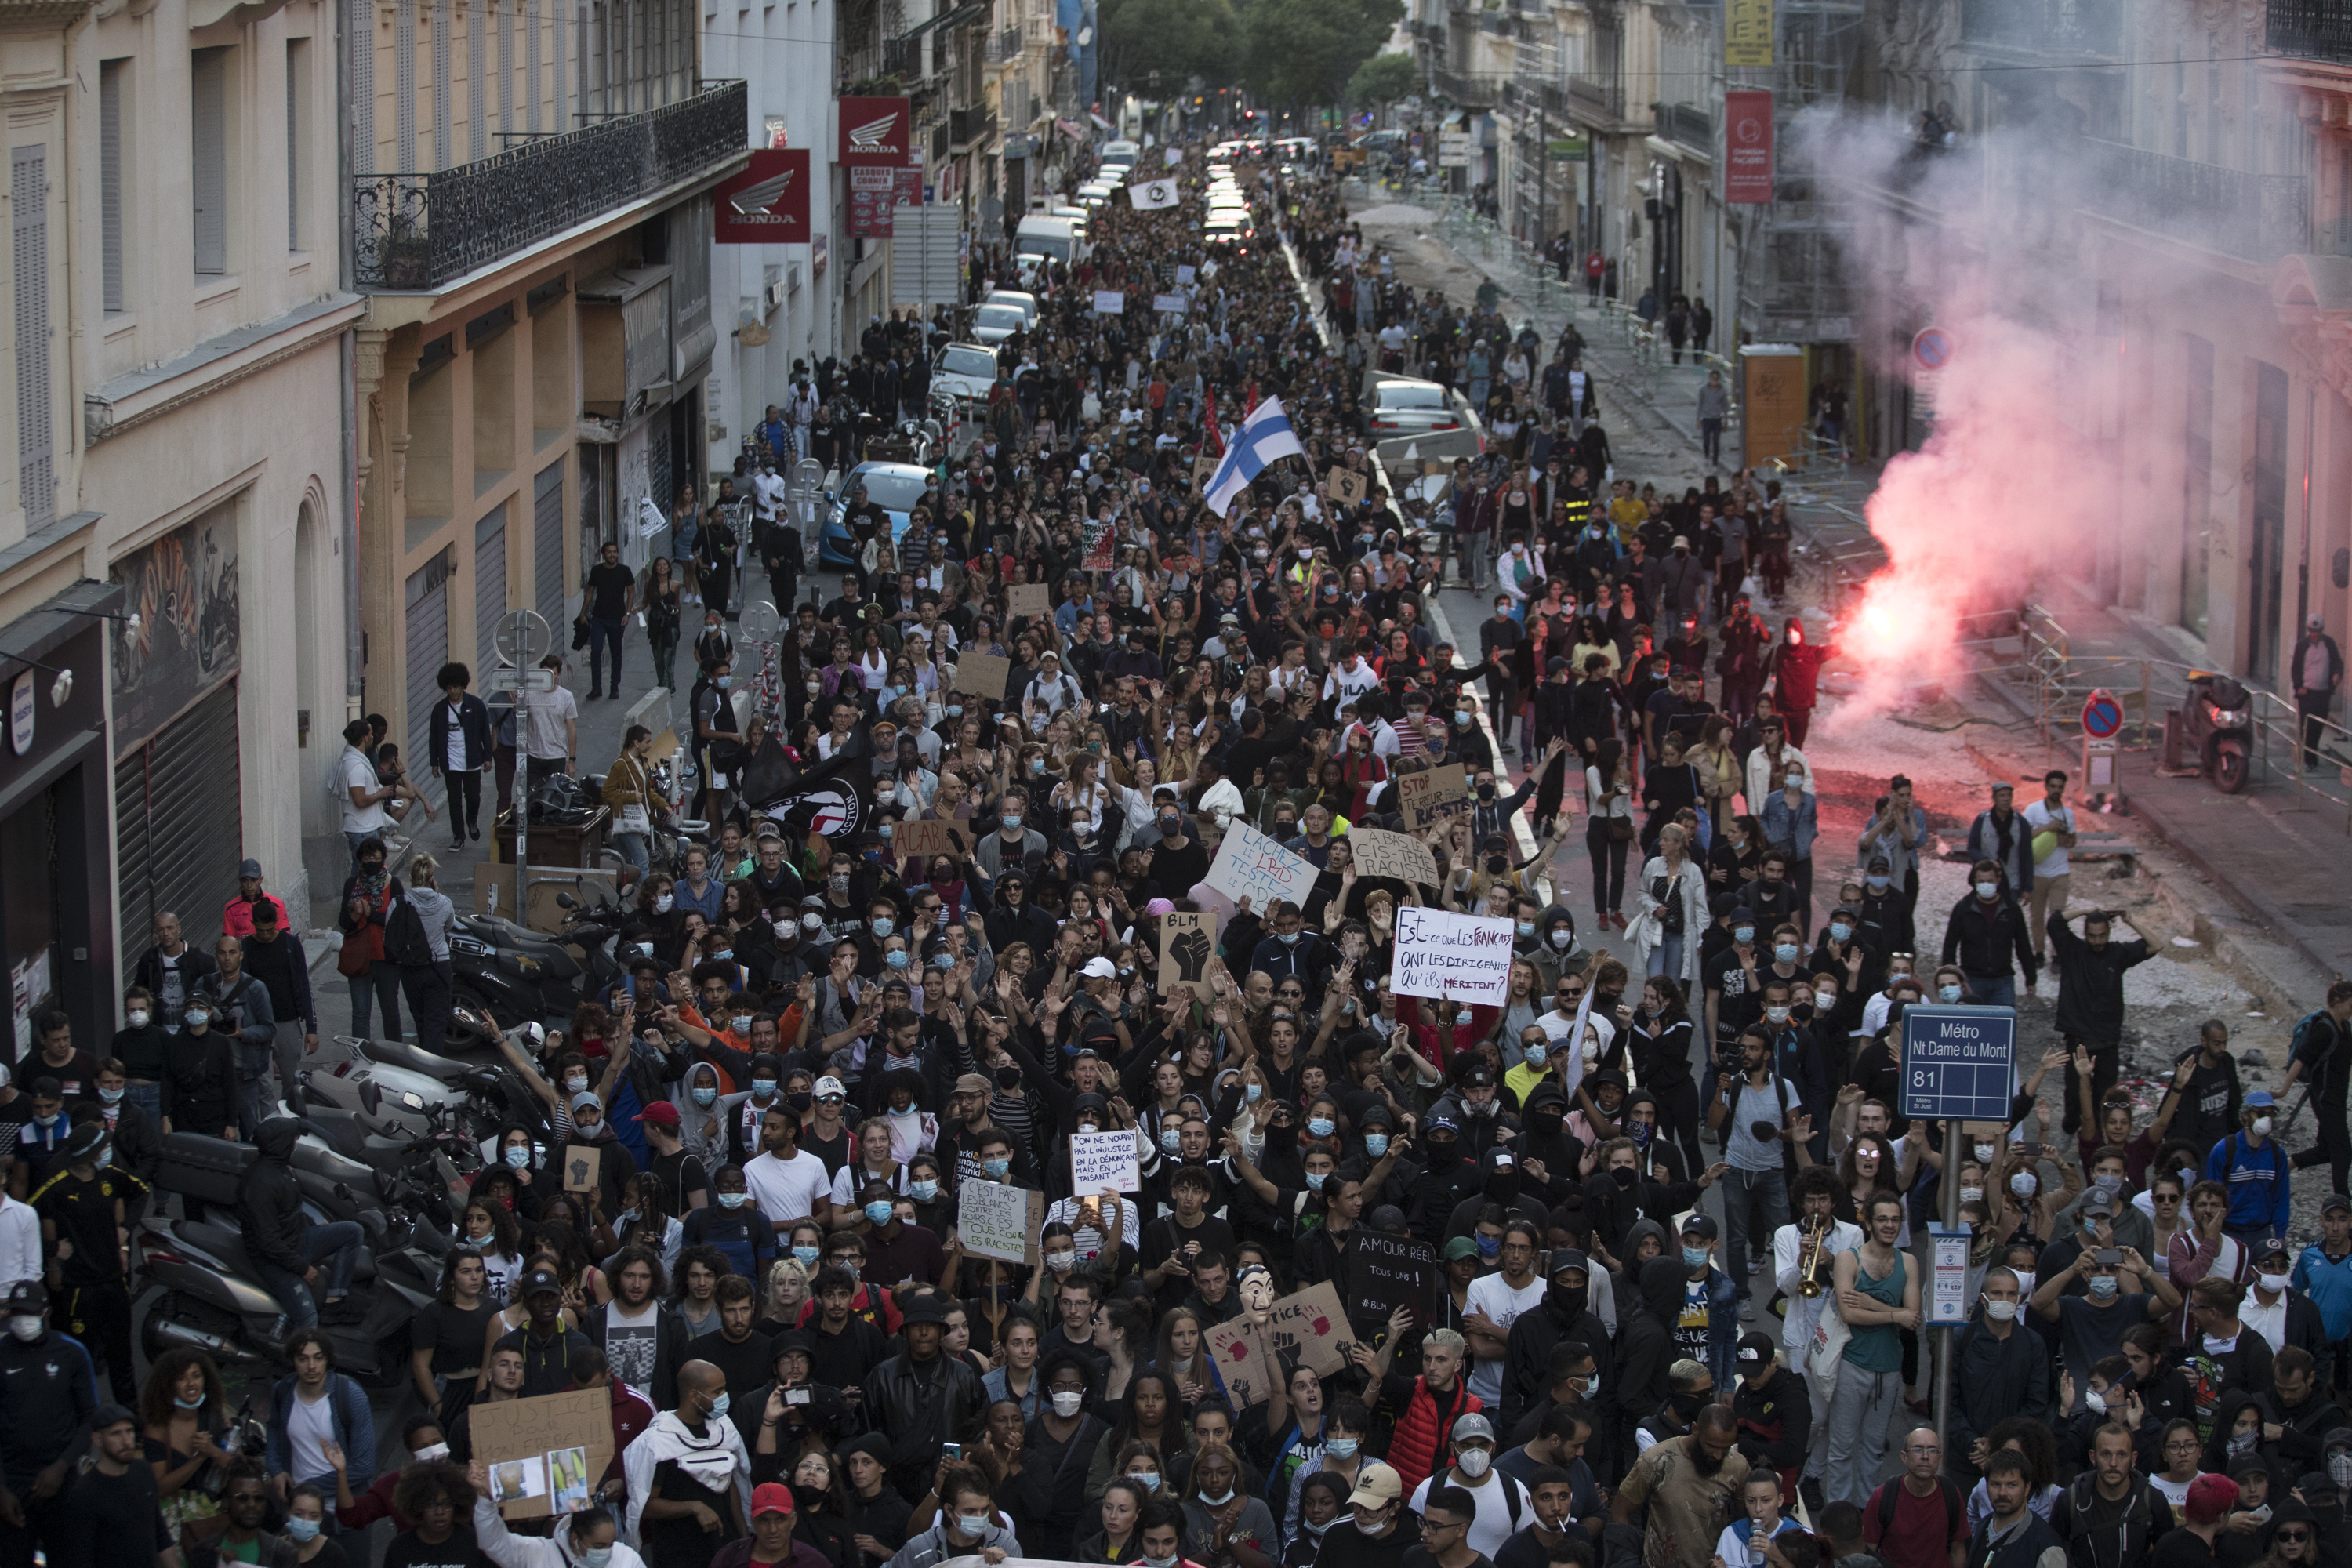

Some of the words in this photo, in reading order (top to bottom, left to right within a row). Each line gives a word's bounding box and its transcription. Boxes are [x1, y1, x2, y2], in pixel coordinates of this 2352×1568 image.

[728, 214, 797, 224] HONDA
[1401, 775, 1430, 797] STOP
[1404, 791, 1443, 811] TERREUR
[839, 793, 855, 834] ACTION
[759, 825, 775, 833] ICON
[1243, 828, 1303, 875] LACHEZ
[1369, 831, 1380, 844] A
[1382, 833, 1408, 848] BAS
[1411, 838, 1423, 853] LE
[1243, 847, 1254, 859] LE
[1256, 853, 1292, 883] LBD
[1365, 859, 1438, 887] RACISTE
[1231, 855, 1294, 902] TESTEZ
[1228, 877, 1238, 887] LE
[1242, 881, 1276, 913] CB
[1167, 914, 1198, 927] BLM
[1457, 929, 1474, 946] LES
[1474, 927, 1512, 949] FRANÇAIS
[1401, 951, 1426, 968] ONT
[1429, 953, 1445, 966] LES
[1446, 956, 1508, 971] DIRIGEANTS
[1940, 1022, 1980, 1039] Métro
[1913, 1040, 1926, 1055] Nt
[1929, 1041, 1960, 1057] Dame
[1963, 1042, 1976, 1058] du
[1980, 1042, 2007, 1058] Mont
[1913, 1070, 1935, 1087] 81
[1094, 1135, 1105, 1144] NE
[1088, 1157, 1098, 1166] LA
[1099, 1153, 1138, 1163] DÉNONÇANT
[962, 1193, 978, 1205] LES
[980, 1197, 1012, 1210] BLANCS
[968, 1181, 994, 1197] C'EST
[998, 1187, 1017, 1203] PAS
[961, 1205, 993, 1215] CONTRE
[995, 1210, 1012, 1219] LES
[961, 1221, 996, 1235] TOUS
[966, 1234, 982, 1247] LES
[985, 1236, 1025, 1254] RACISTES
[1359, 1237, 1406, 1257] AMOUR
[1410, 1245, 1432, 1263] RÉEL
[1370, 1265, 1391, 1277] TOUS
[1242, 1304, 1301, 1336] JTICE
[479, 1393, 604, 1428] JUSTICE
[510, 1420, 559, 1436] POUR
[1469, 1417, 1481, 1428] NY
[479, 1443, 514, 1461] MON
[524, 1432, 573, 1449] FRERE
